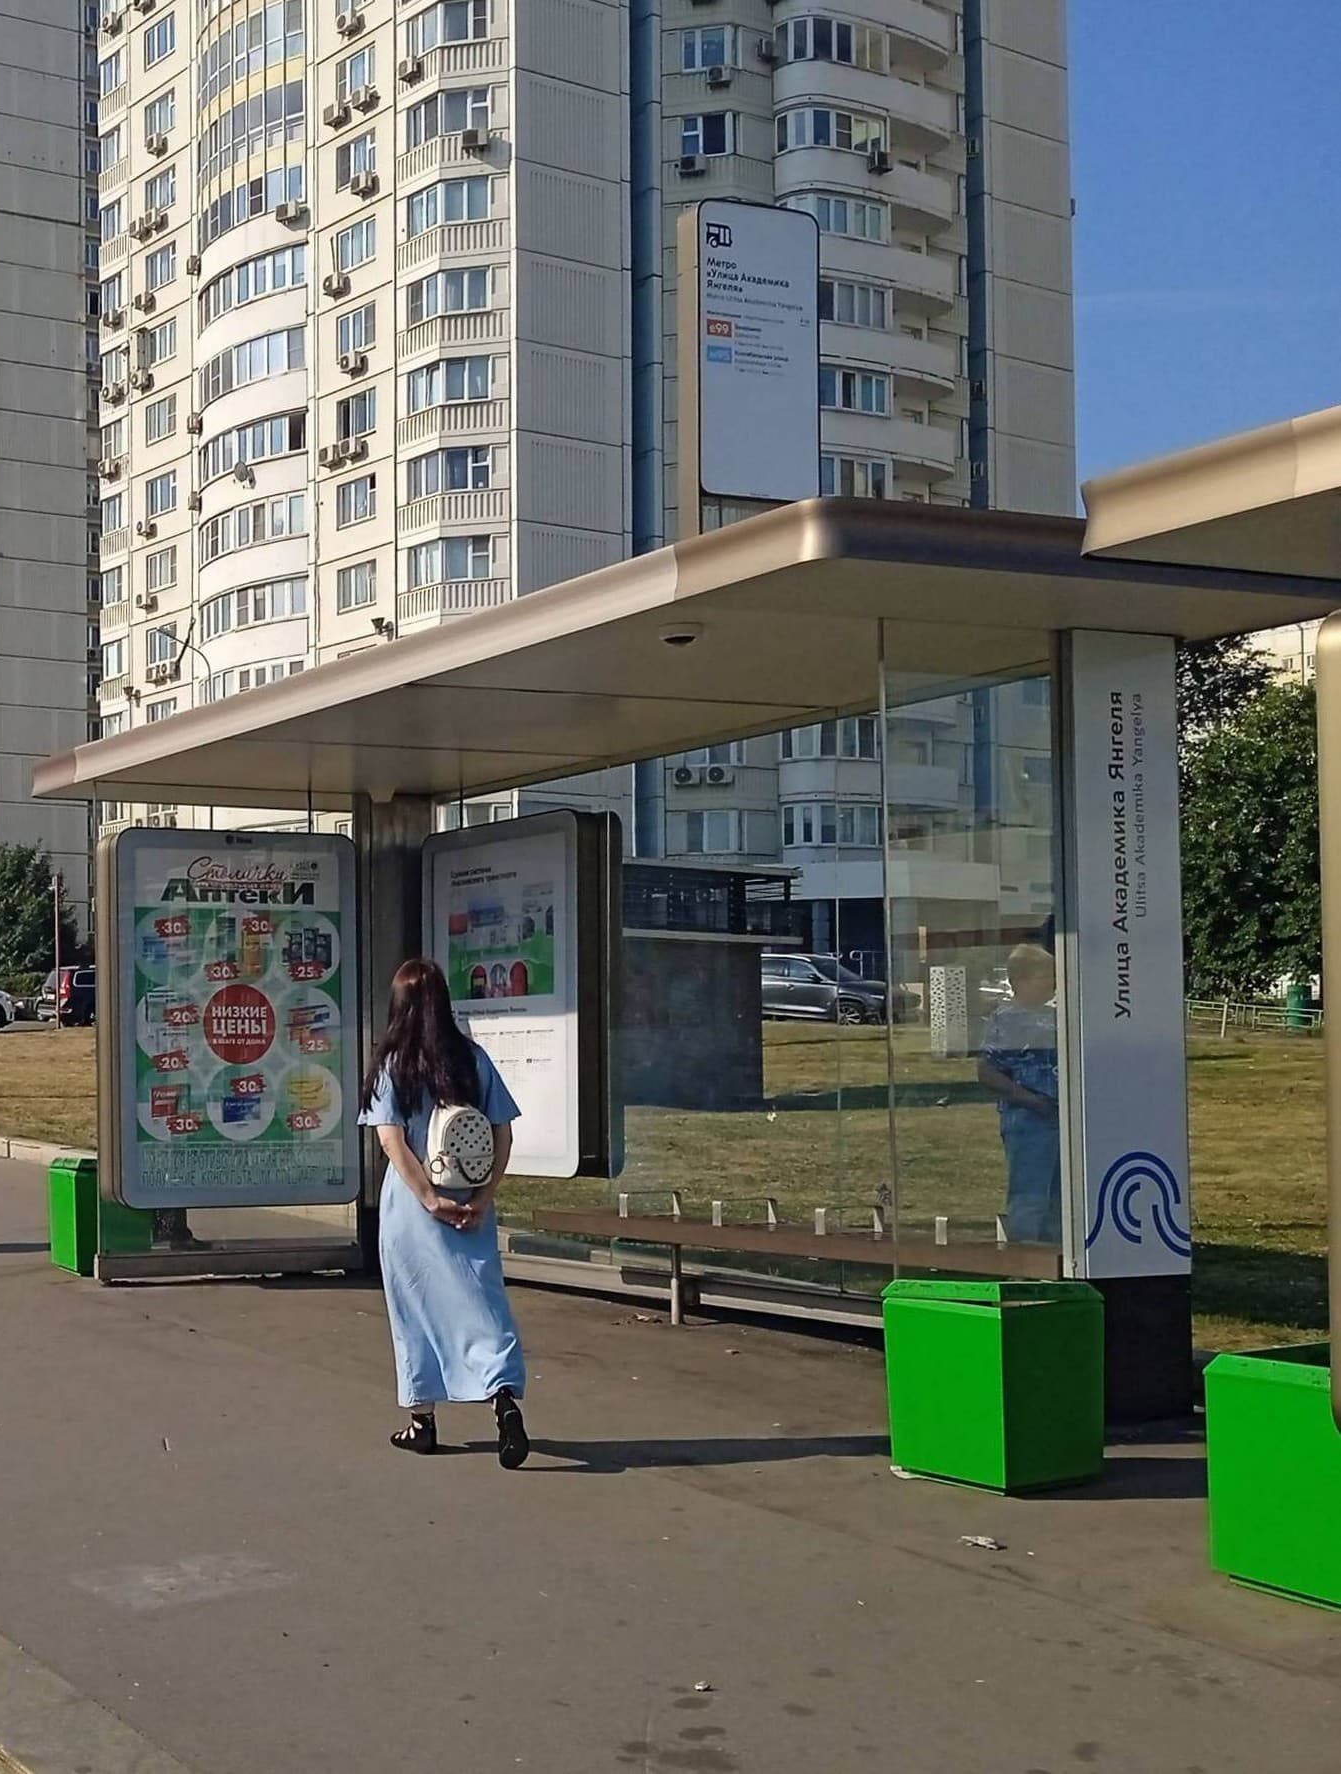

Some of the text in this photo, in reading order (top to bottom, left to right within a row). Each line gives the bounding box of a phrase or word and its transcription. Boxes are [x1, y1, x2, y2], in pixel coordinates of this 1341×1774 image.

[707, 257, 737, 269] Метро
[740, 272, 790, 288] Академика
[1131, 693, 1147, 918] Ulitsa Akademika Yangelya
[1109, 691, 1132, 1018] Улица Академика Янгеля
[212, 1006, 267, 1018] НИЗКИЕ
[212, 1019, 267, 1037] ЦЕНЫ
